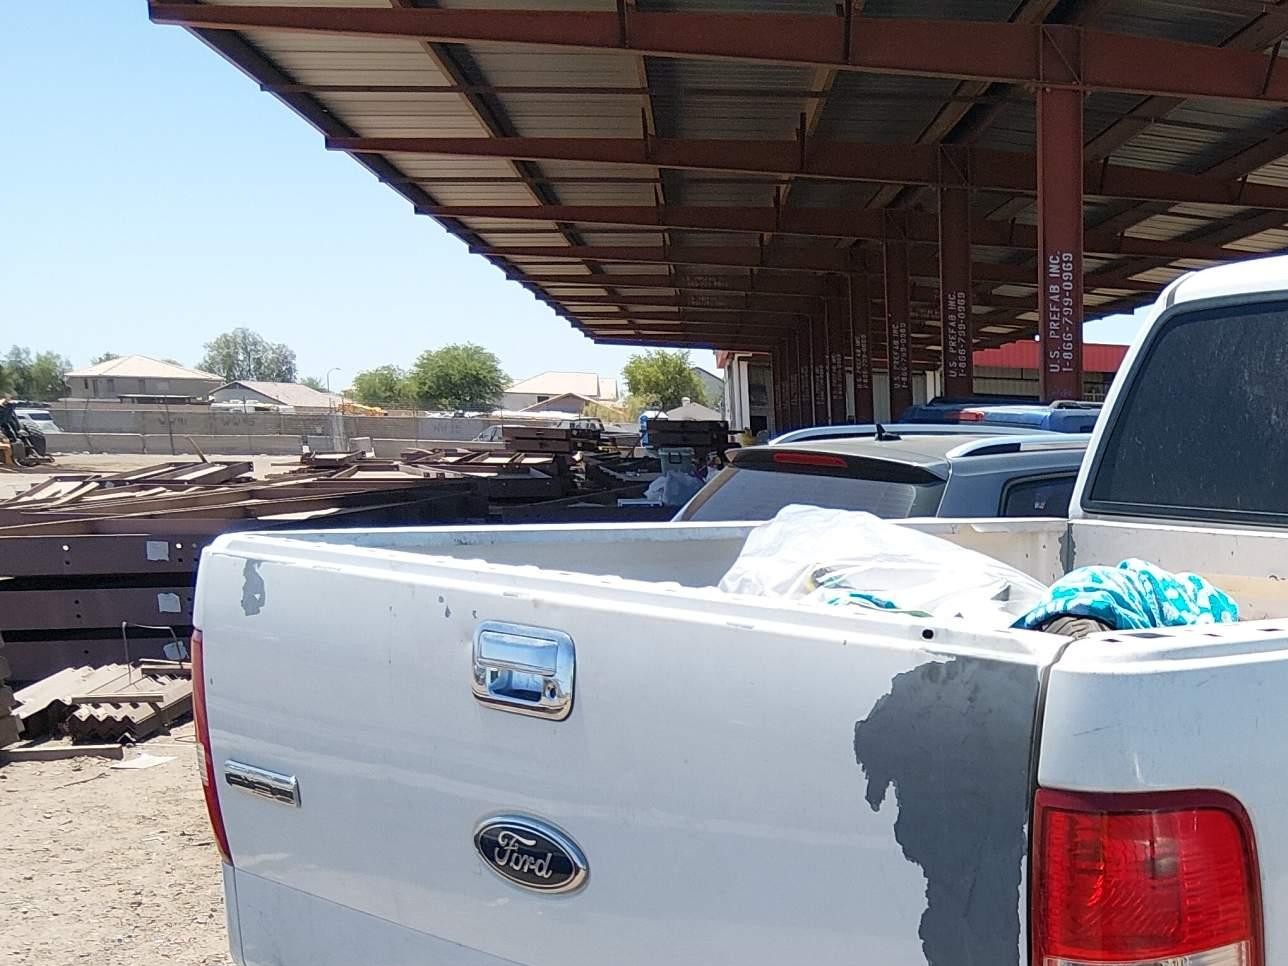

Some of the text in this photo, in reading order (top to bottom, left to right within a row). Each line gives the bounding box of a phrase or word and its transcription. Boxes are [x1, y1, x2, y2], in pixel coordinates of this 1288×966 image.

[948, 314, 958, 353] PREFAB
[1048, 250, 1060, 373] U.S. PREFAB INC.
[1062, 252, 1073, 372] 1-866-799-0969
[494, 831, 553, 878] Ford
